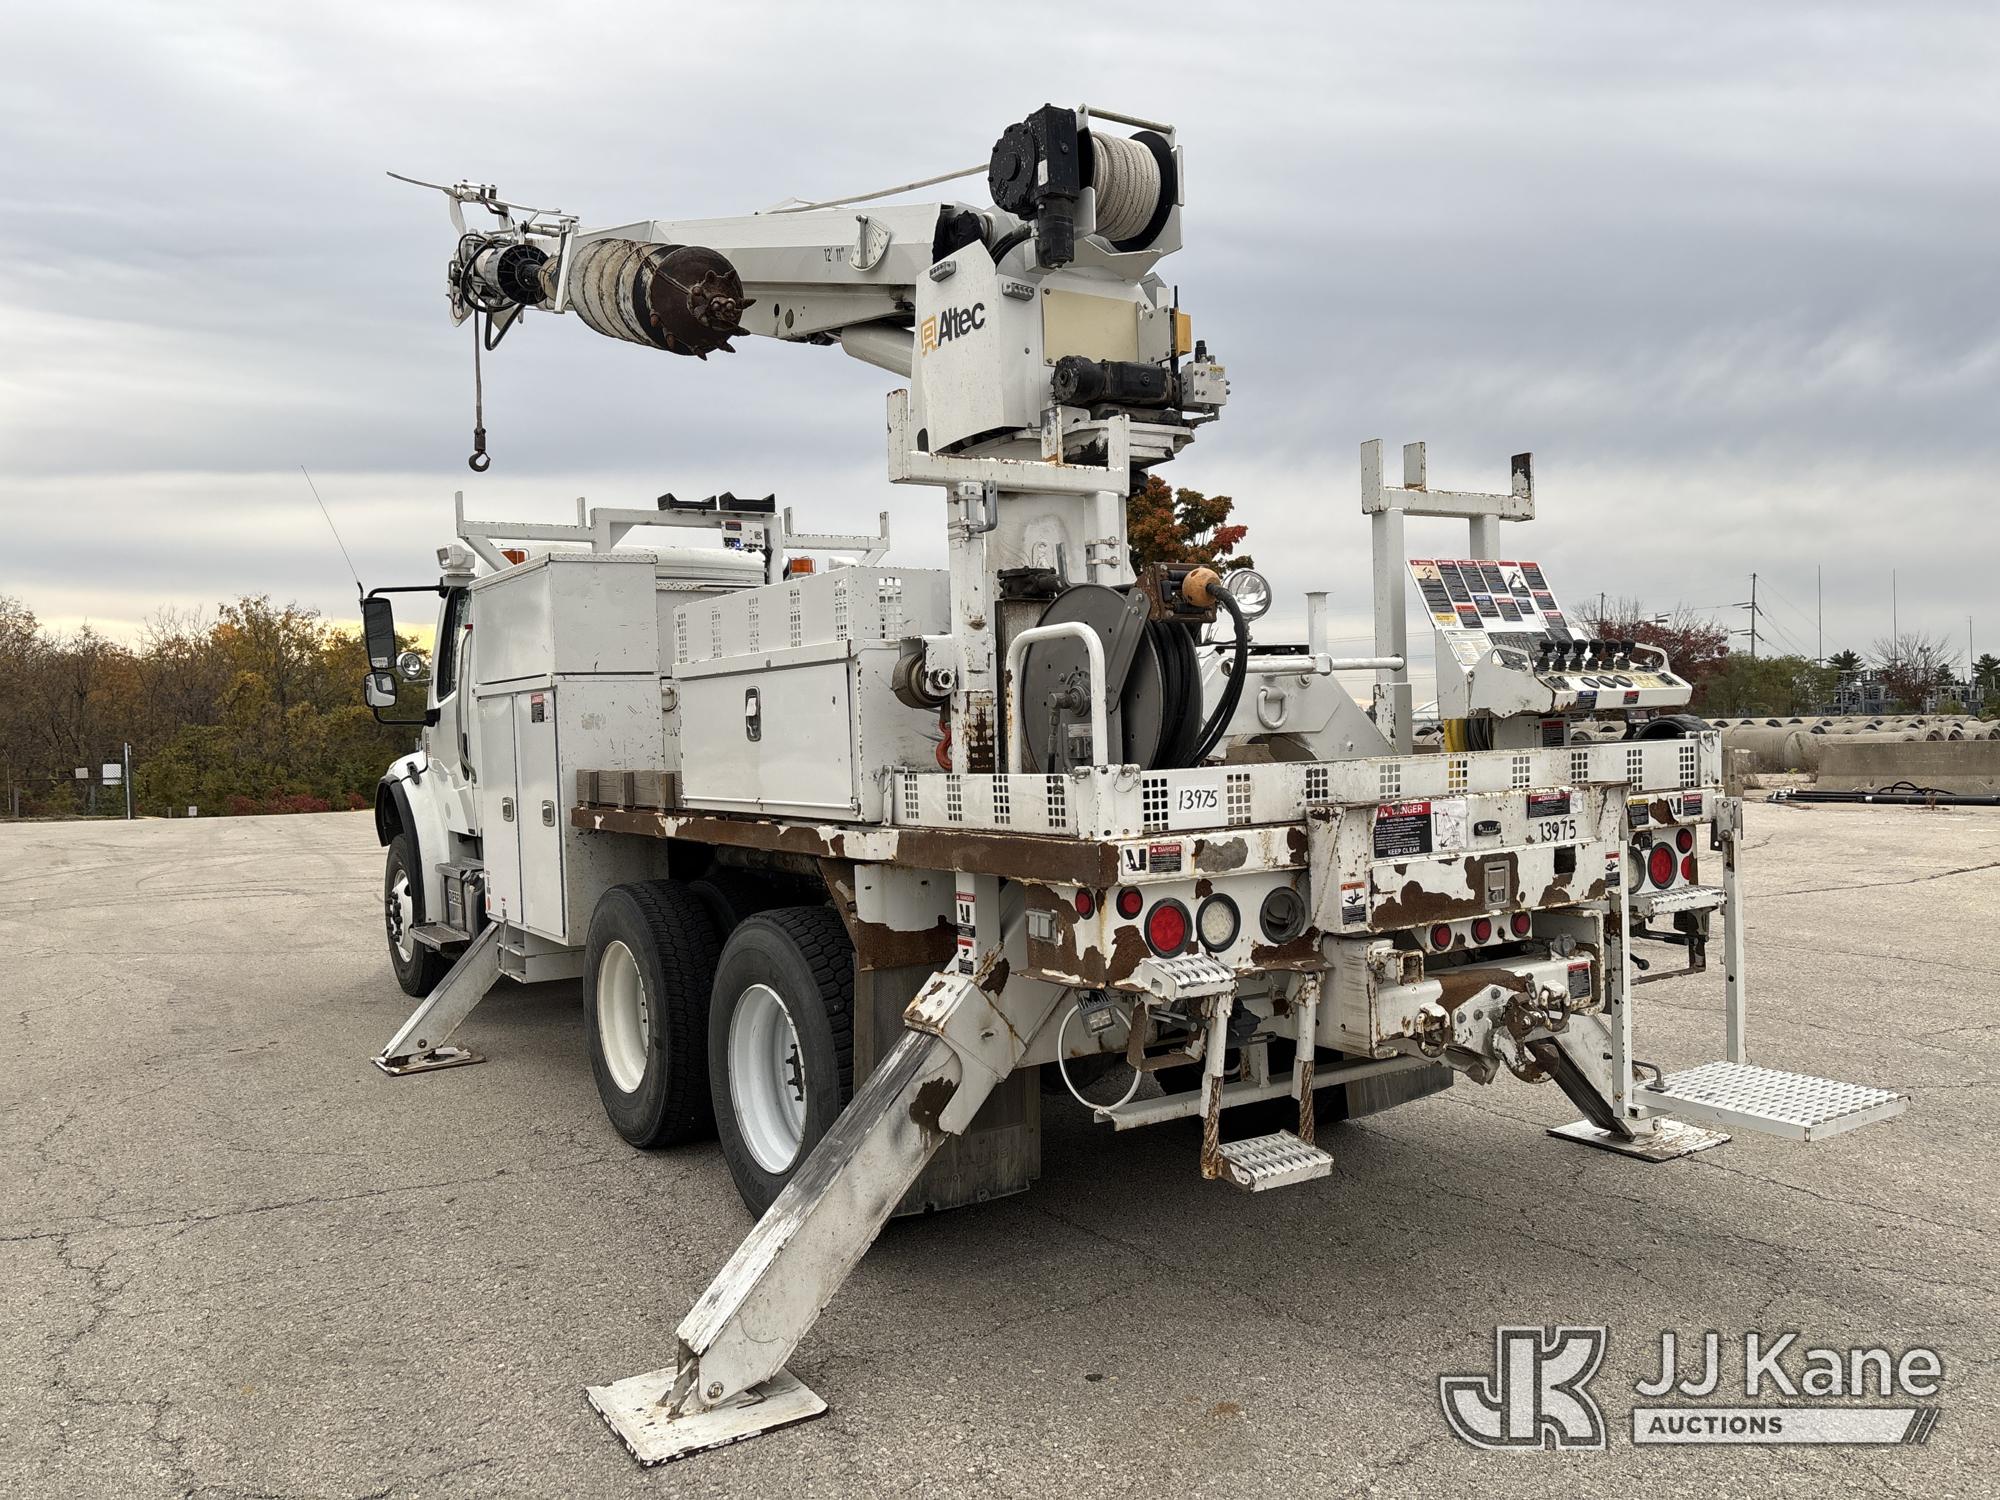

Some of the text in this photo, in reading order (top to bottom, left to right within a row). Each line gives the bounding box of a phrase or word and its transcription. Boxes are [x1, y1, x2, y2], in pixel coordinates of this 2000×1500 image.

[938, 303, 985, 347] Altec
[1179, 789, 1218, 811] 13975
[1392, 804, 1423, 815] NGER
[1539, 819, 1577, 842] 13975
[1157, 845, 1180, 853] DANGER
[1402, 846, 1420, 854] CLEAR
